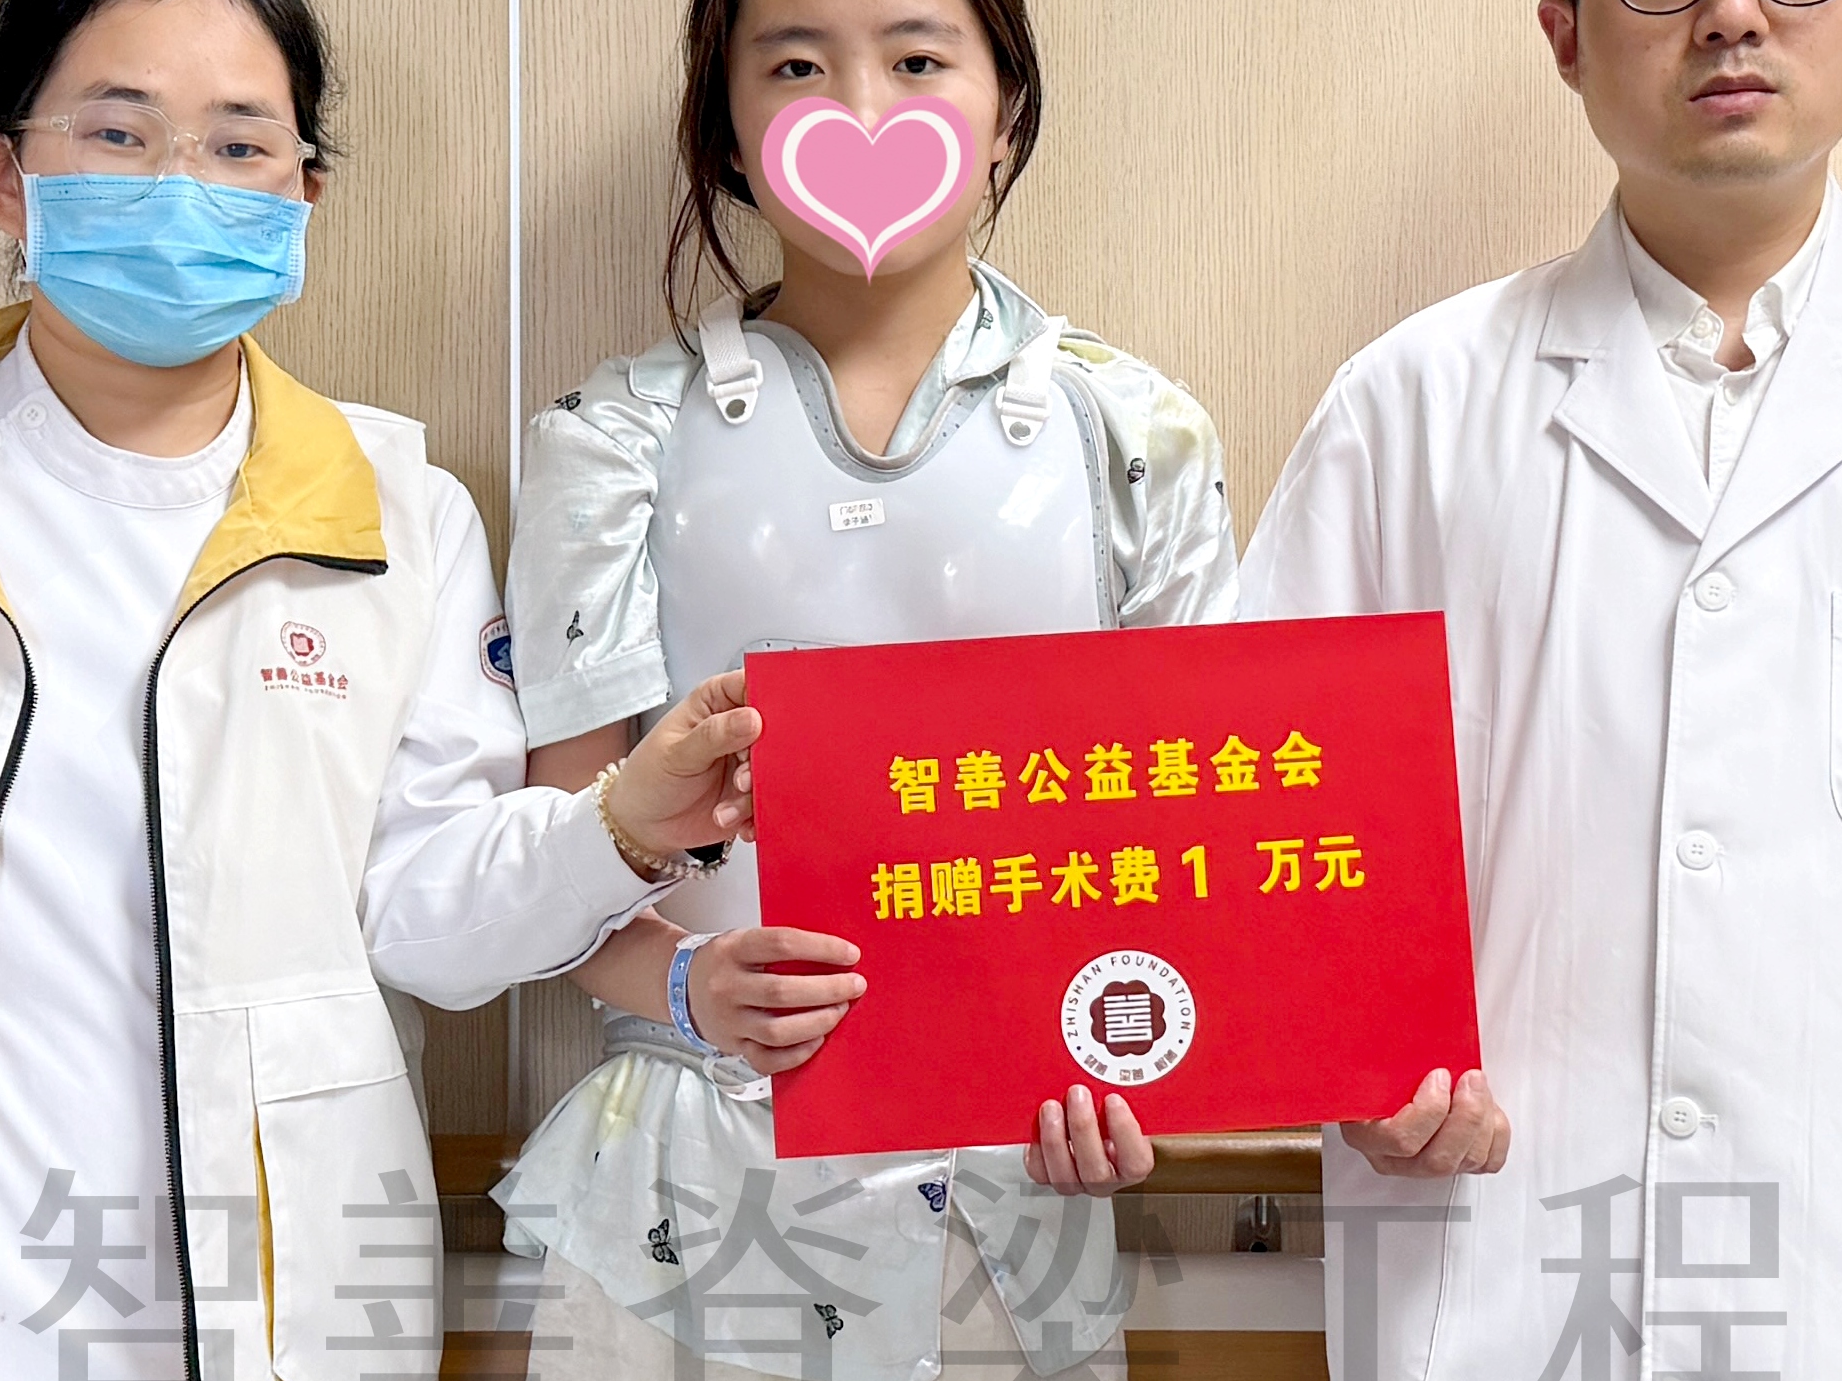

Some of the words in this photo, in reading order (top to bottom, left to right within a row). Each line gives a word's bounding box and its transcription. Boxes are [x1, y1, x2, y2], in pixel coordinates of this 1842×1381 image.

[888, 730, 1324, 816] 智善公益基金会
[1066, 964, 1102, 1039] ZHISHAN
[1110, 954, 1191, 1030] FOUNDATION
